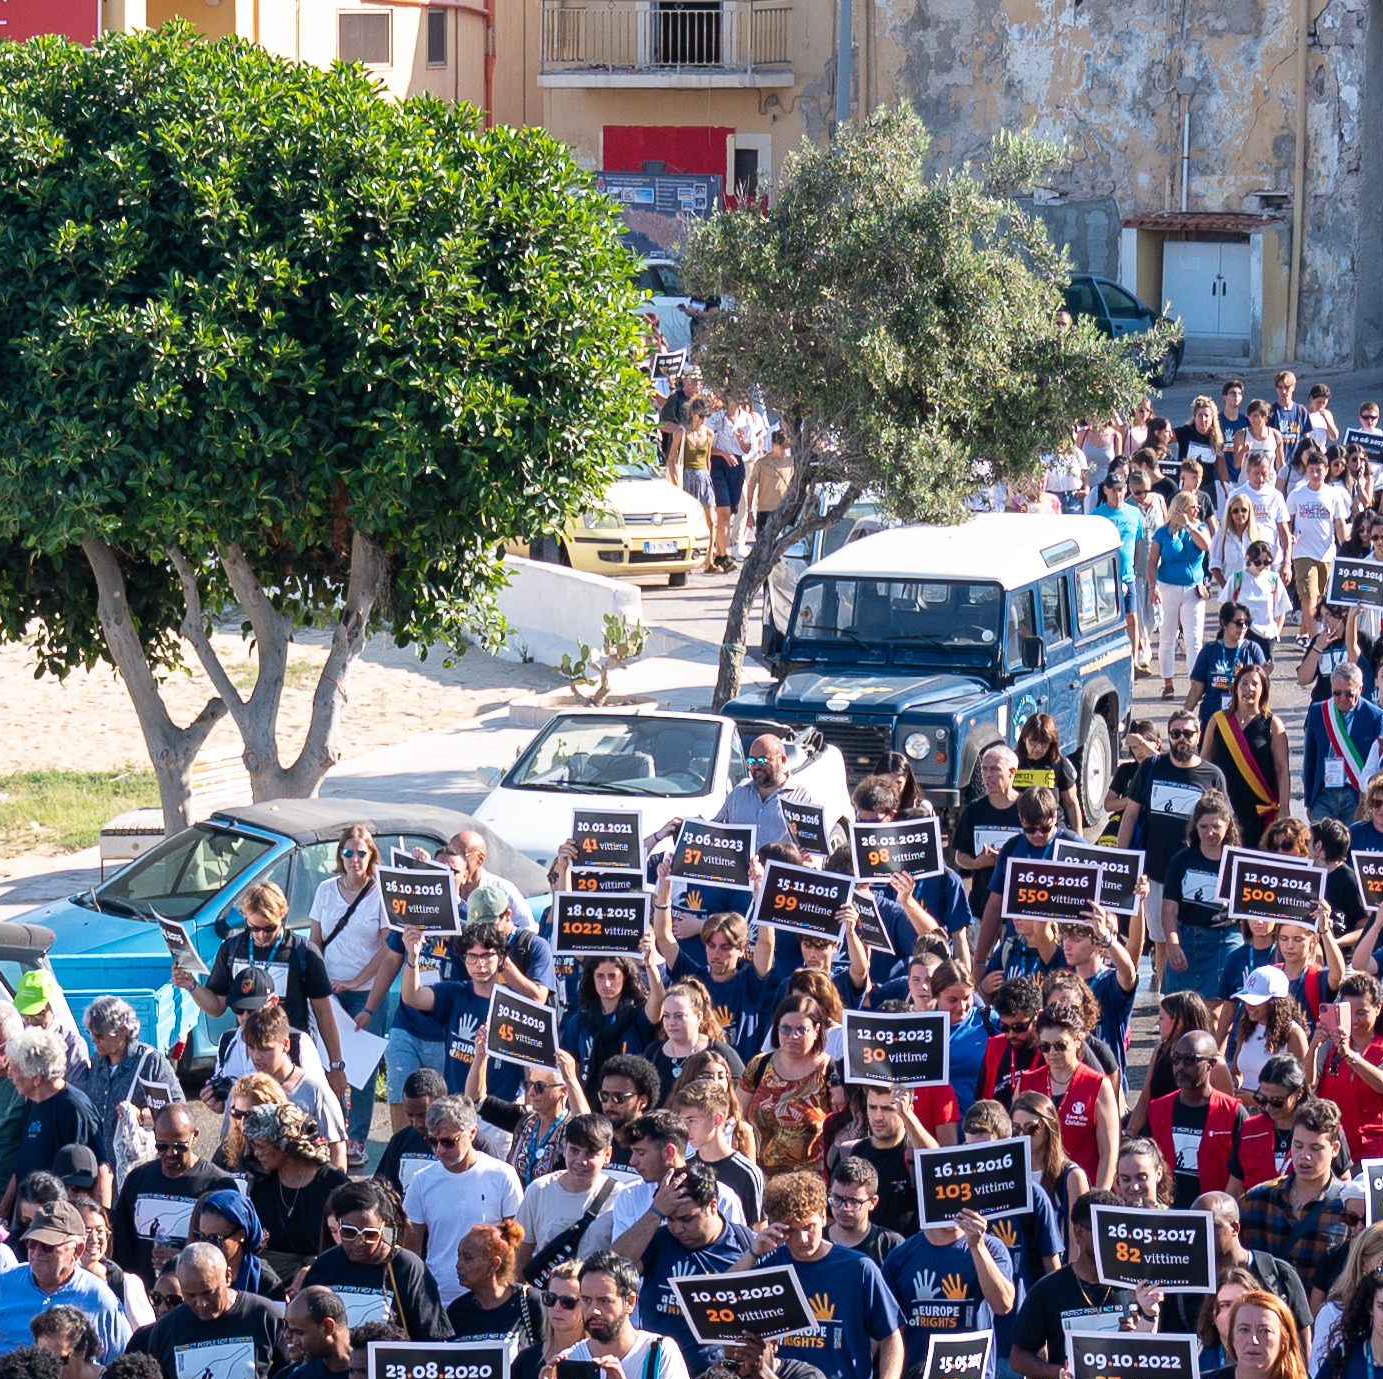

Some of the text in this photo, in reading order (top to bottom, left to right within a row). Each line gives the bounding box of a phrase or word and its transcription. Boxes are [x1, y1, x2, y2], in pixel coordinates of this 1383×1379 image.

[1341, 580, 1357, 591] 42
[577, 822, 632, 834] 20.02.2021
[582, 838, 629, 853] 41 vittime
[861, 832, 929, 848] 26.02.2023
[683, 848, 736, 868] 37 vittime
[869, 849, 926, 866] 98 vittime
[385, 881, 443, 896] 26.10.2016
[577, 878, 631, 892] 29 vittime
[777, 878, 839, 899] 15.11.2016
[1017, 872, 1089, 888] 26.05.2016
[1244, 871, 1312, 893] 12.09.2014
[775, 894, 833, 917] 99 vittime
[1017, 888, 1086, 906] 550 vittime
[1241, 888, 1311, 909] 500 vittime
[392, 898, 440, 916] 97 vittime
[566, 906, 637, 921] 18.04.2015
[563, 921, 639, 937] 1022 vittime
[498, 1004, 545, 1033] 30.12.2019
[498, 1022, 543, 1049] 45 vittime
[857, 1028, 933, 1046] 12.03.2023
[863, 1046, 928, 1065] 30 vittime
[934, 1154, 1013, 1179] 16.11.2016
[935, 1179, 1016, 1202] 103 vittime
[1107, 1222, 1196, 1245] 26.05.2017
[1115, 1242, 1190, 1265] 82 vittime
[691, 1284, 785, 1304] 10.03.2020
[706, 1306, 785, 1323] 20 vittime
[911, 1306, 960, 1317] aEUROPE
[909, 1316, 957, 1328] ofRIGHTS
[1083, 1352, 1182, 1371] 09.10.2022
